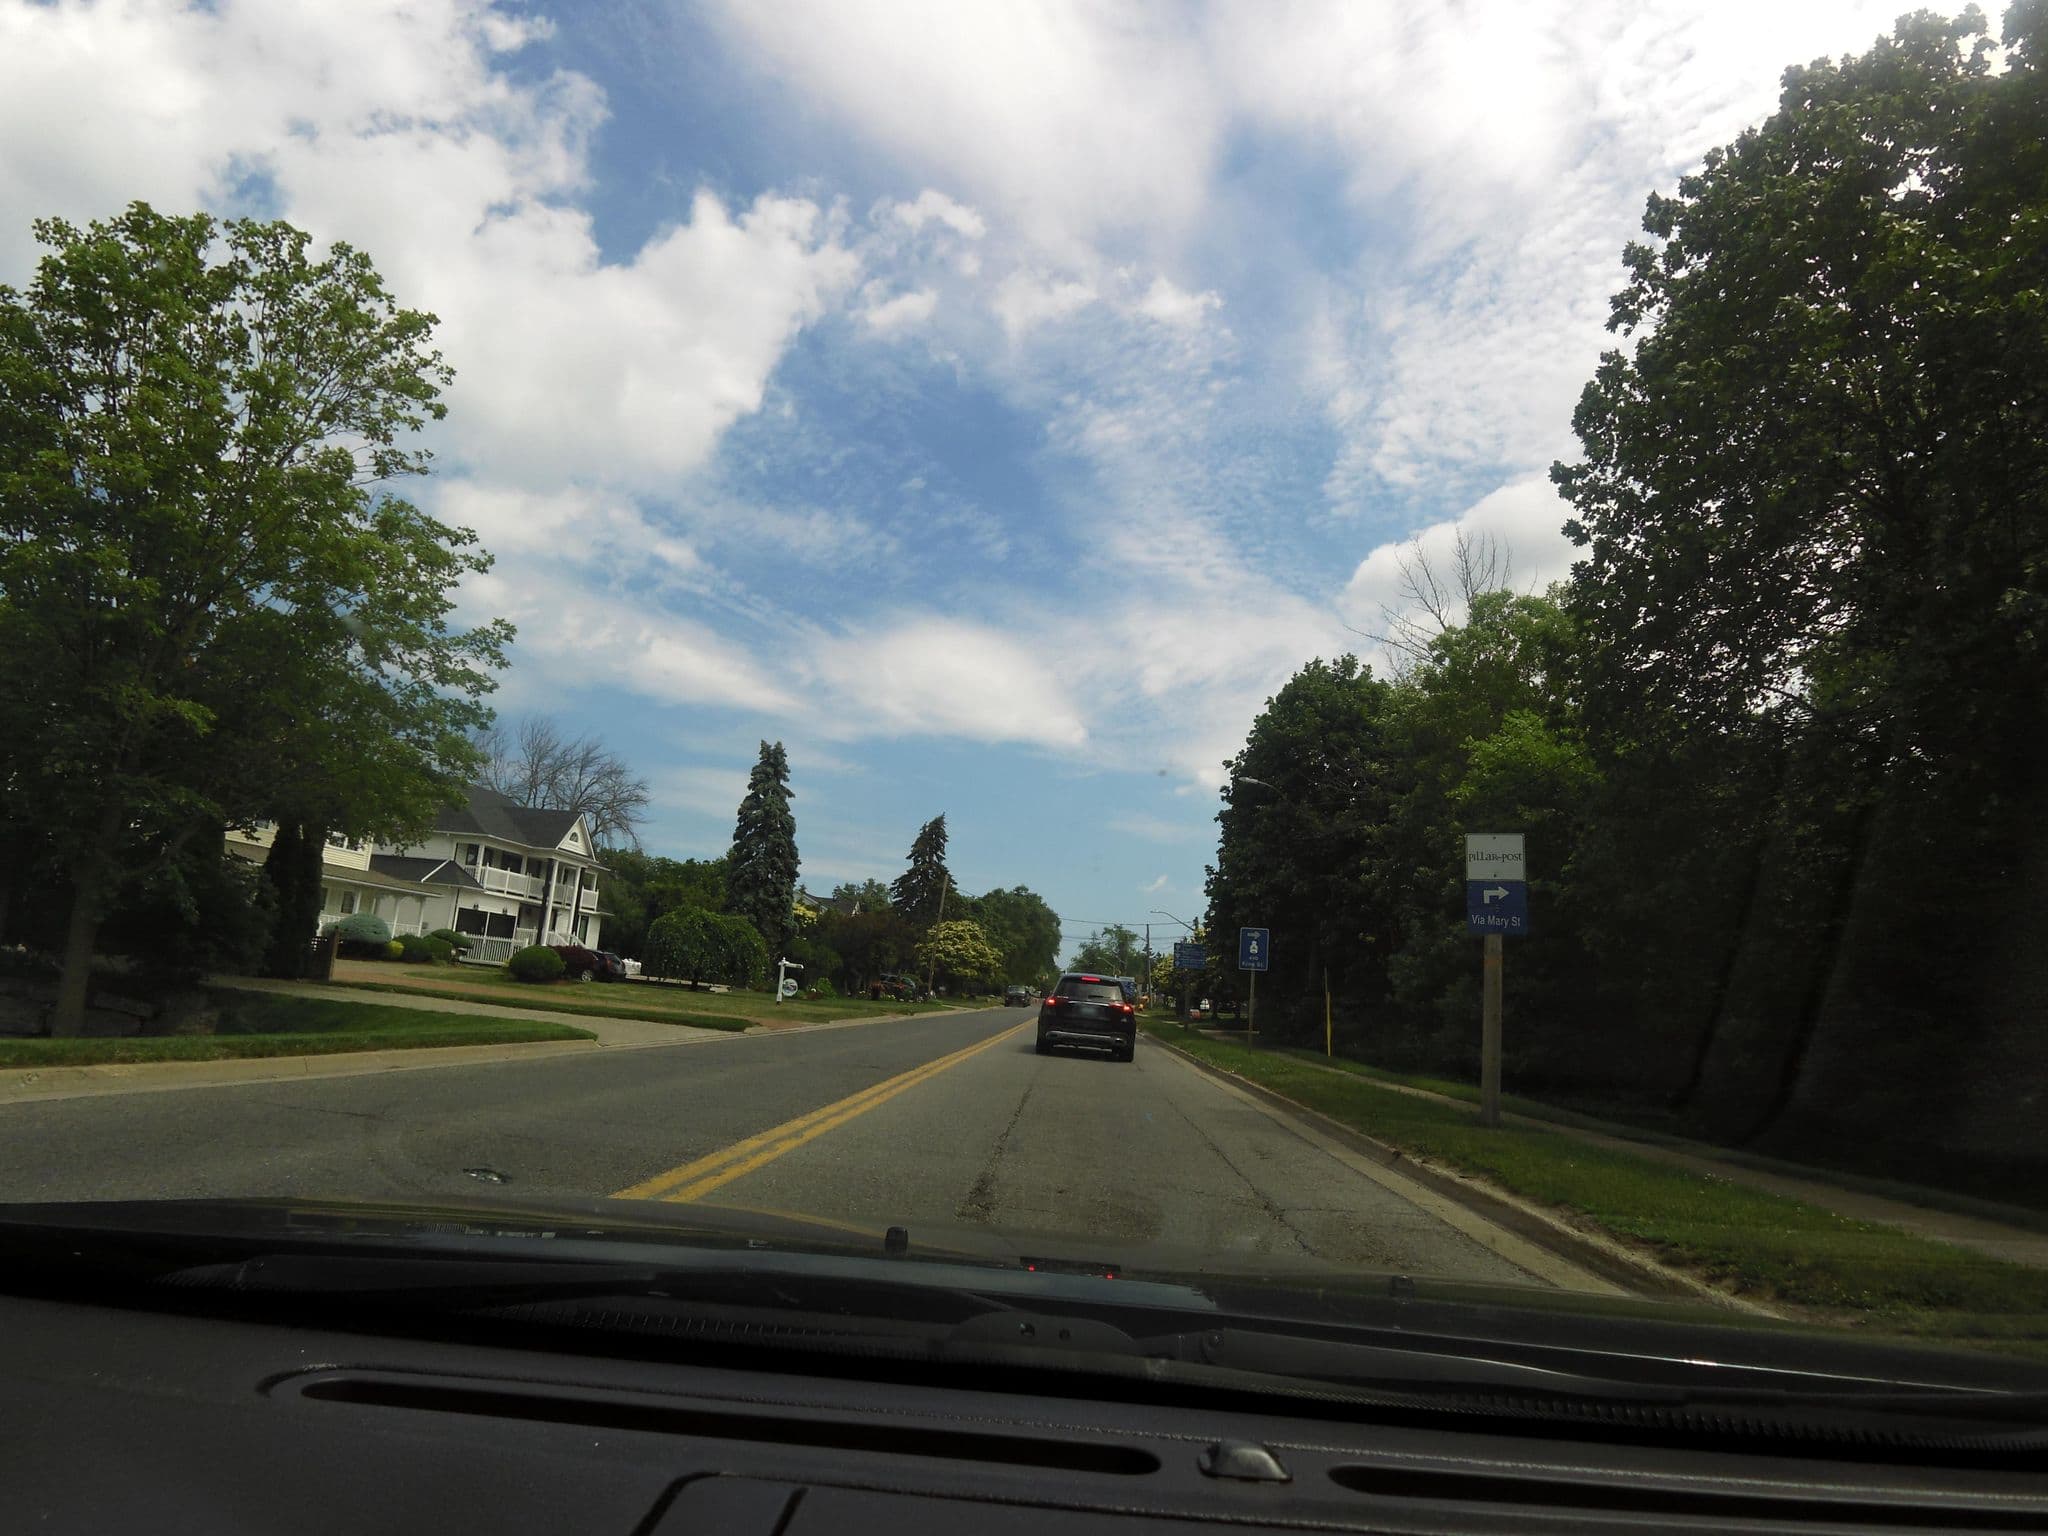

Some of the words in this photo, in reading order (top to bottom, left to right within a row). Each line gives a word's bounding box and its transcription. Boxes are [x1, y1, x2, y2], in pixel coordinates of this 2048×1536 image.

[1471, 914, 1485, 925] Via
[1487, 914, 1509, 929] Mary
[1511, 916, 1521, 927] St
